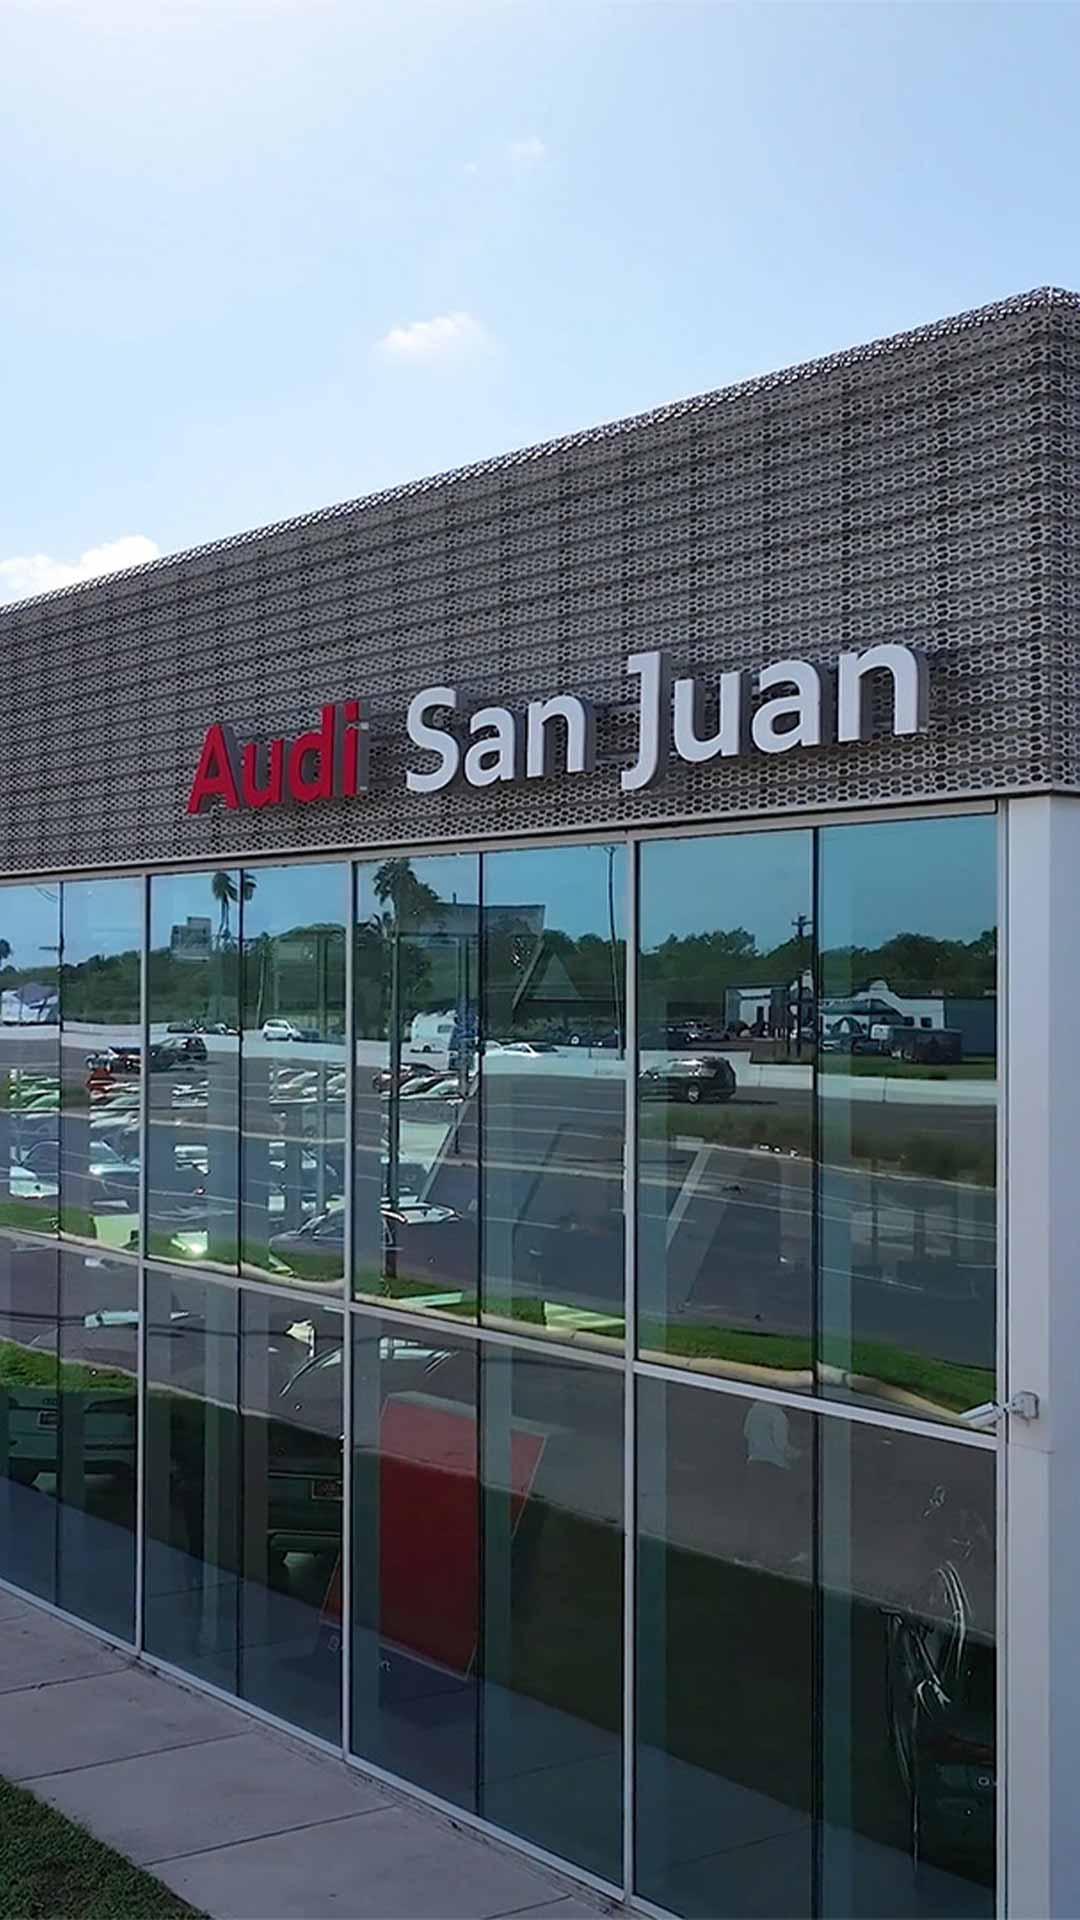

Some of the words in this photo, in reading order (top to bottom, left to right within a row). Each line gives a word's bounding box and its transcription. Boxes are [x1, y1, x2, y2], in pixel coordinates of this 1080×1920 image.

[187, 698, 360, 814] Audi
[406, 686, 586, 792] San
[621, 644, 919, 790] Juan
